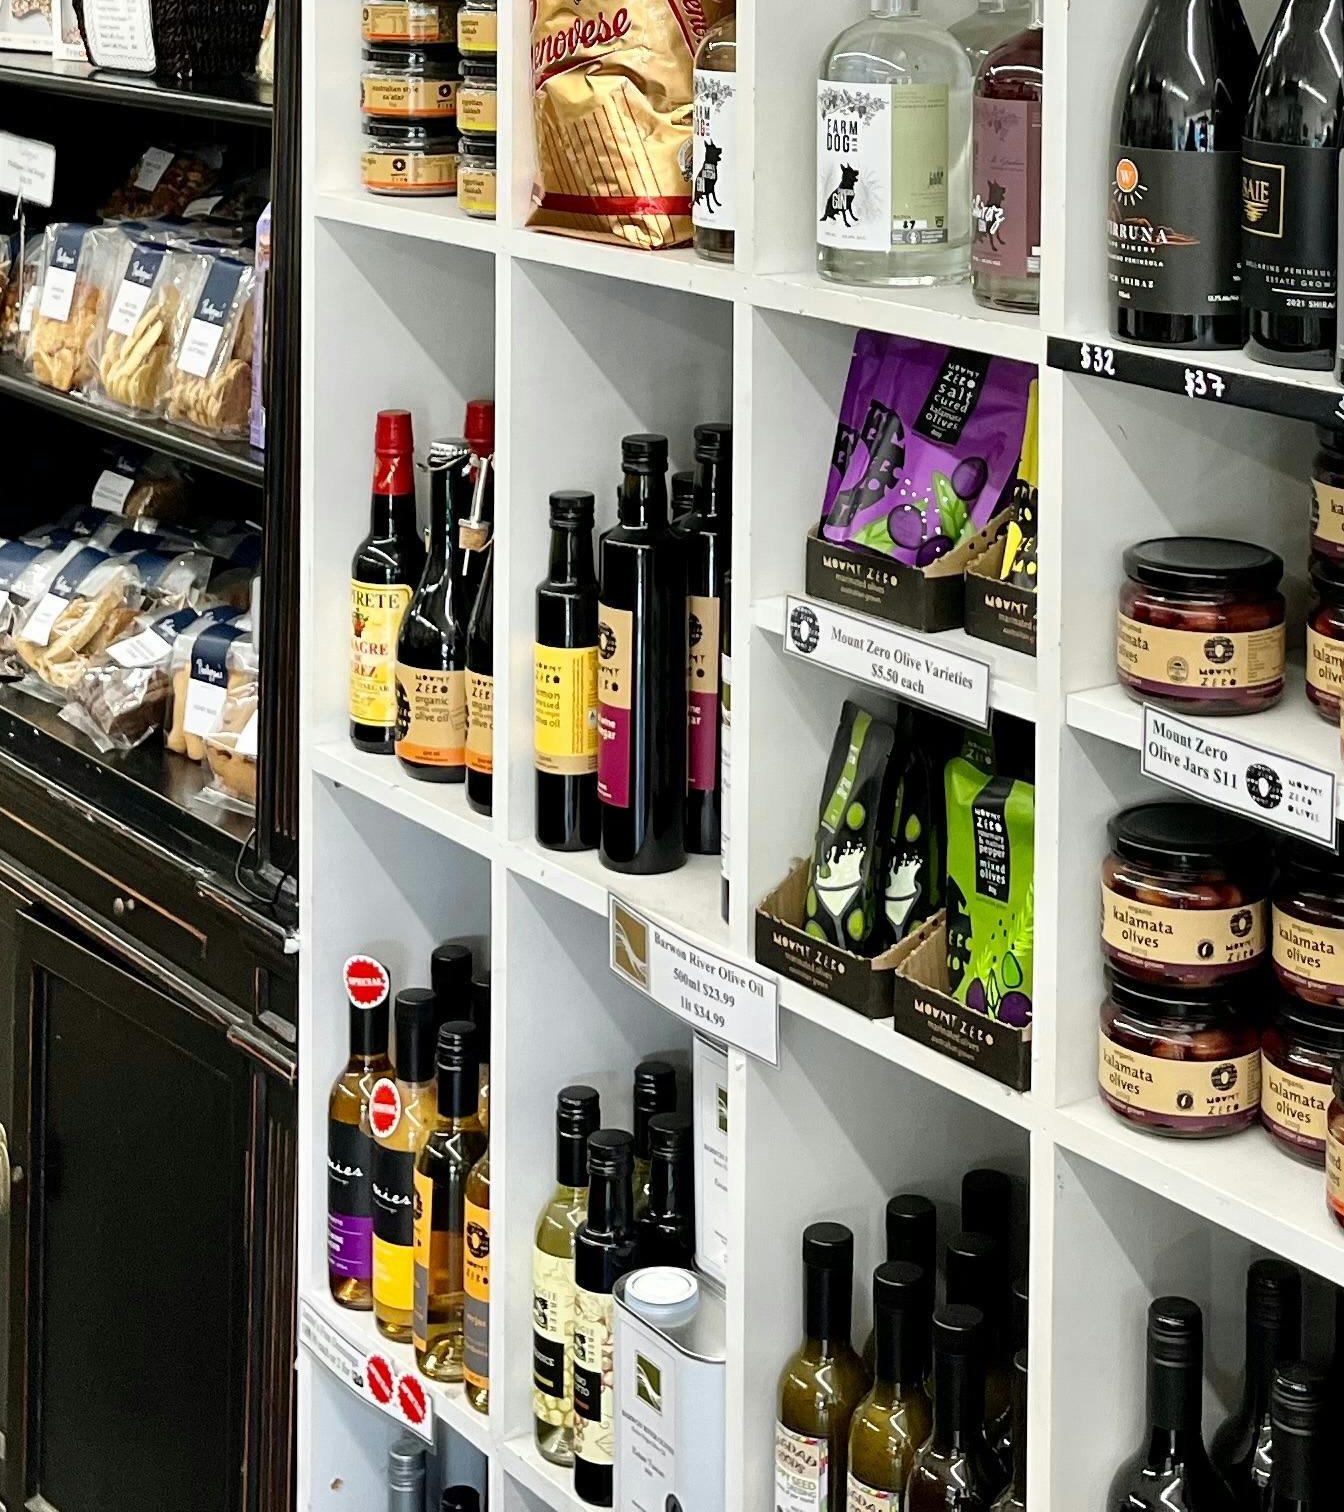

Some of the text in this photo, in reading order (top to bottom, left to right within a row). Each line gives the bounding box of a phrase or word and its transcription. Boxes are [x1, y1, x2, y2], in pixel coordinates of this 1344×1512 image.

[531, 0, 632, 66] enovese
[827, 118, 858, 135] FARM
[832, 192, 848, 210] GIN
[1080, 343, 1116, 376] $32
[939, 385, 974, 402] salt
[1185, 368, 1225, 398] $37
[934, 394, 970, 414] cured
[925, 412, 960, 431] olives
[831, 625, 974, 690] Mount Zero Olive Varieties
[870, 662, 924, 695] $5.50 each
[415, 695, 449, 706] organic
[1152, 719, 1228, 763] Mount Zero
[1148, 740, 1237, 790] Olive Jars $11
[1112, 904, 1174, 936] kalamata
[1121, 928, 1159, 949] olives
[654, 931, 764, 998] Barwon River Olive Oil
[673, 967, 735, 1008] 500ml $23.99
[693, 1003, 725, 1028] $34.99
